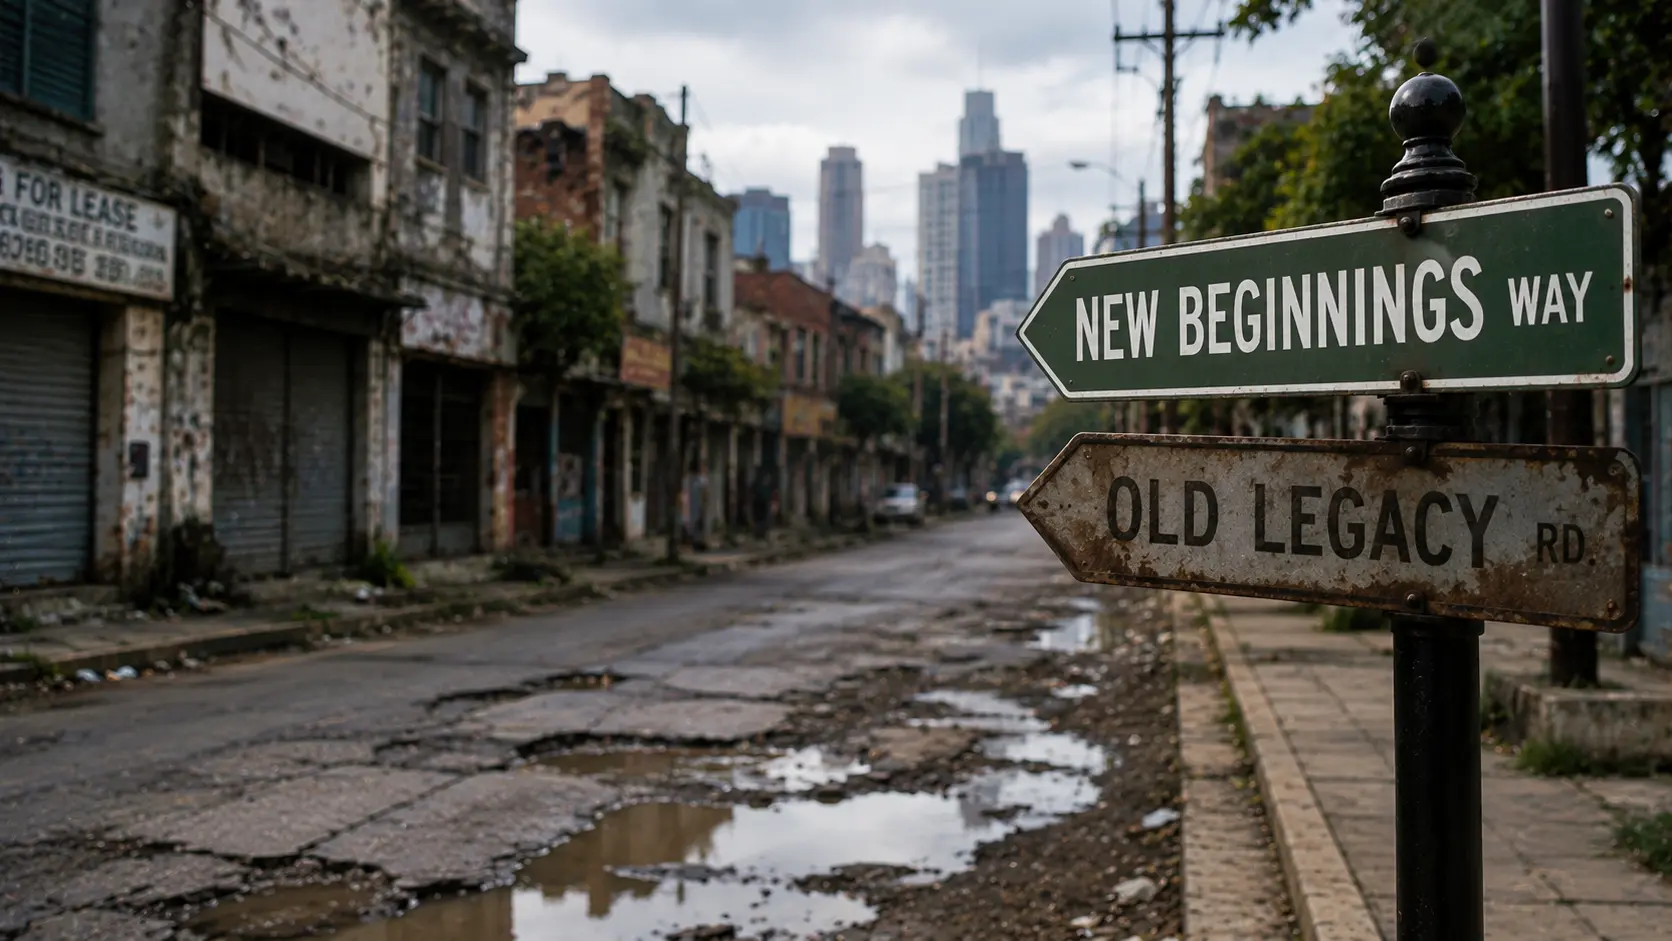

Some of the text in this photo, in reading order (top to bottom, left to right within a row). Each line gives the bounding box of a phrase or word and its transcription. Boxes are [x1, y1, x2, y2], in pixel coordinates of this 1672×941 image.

[16, 172, 62, 212] FOR
[71, 187, 139, 233] LEASE
[1076, 255, 1593, 361] NEW BEGINNINGS WAY
[1107, 477, 1219, 547] OLD
[1254, 483, 1500, 569] LEGACY
